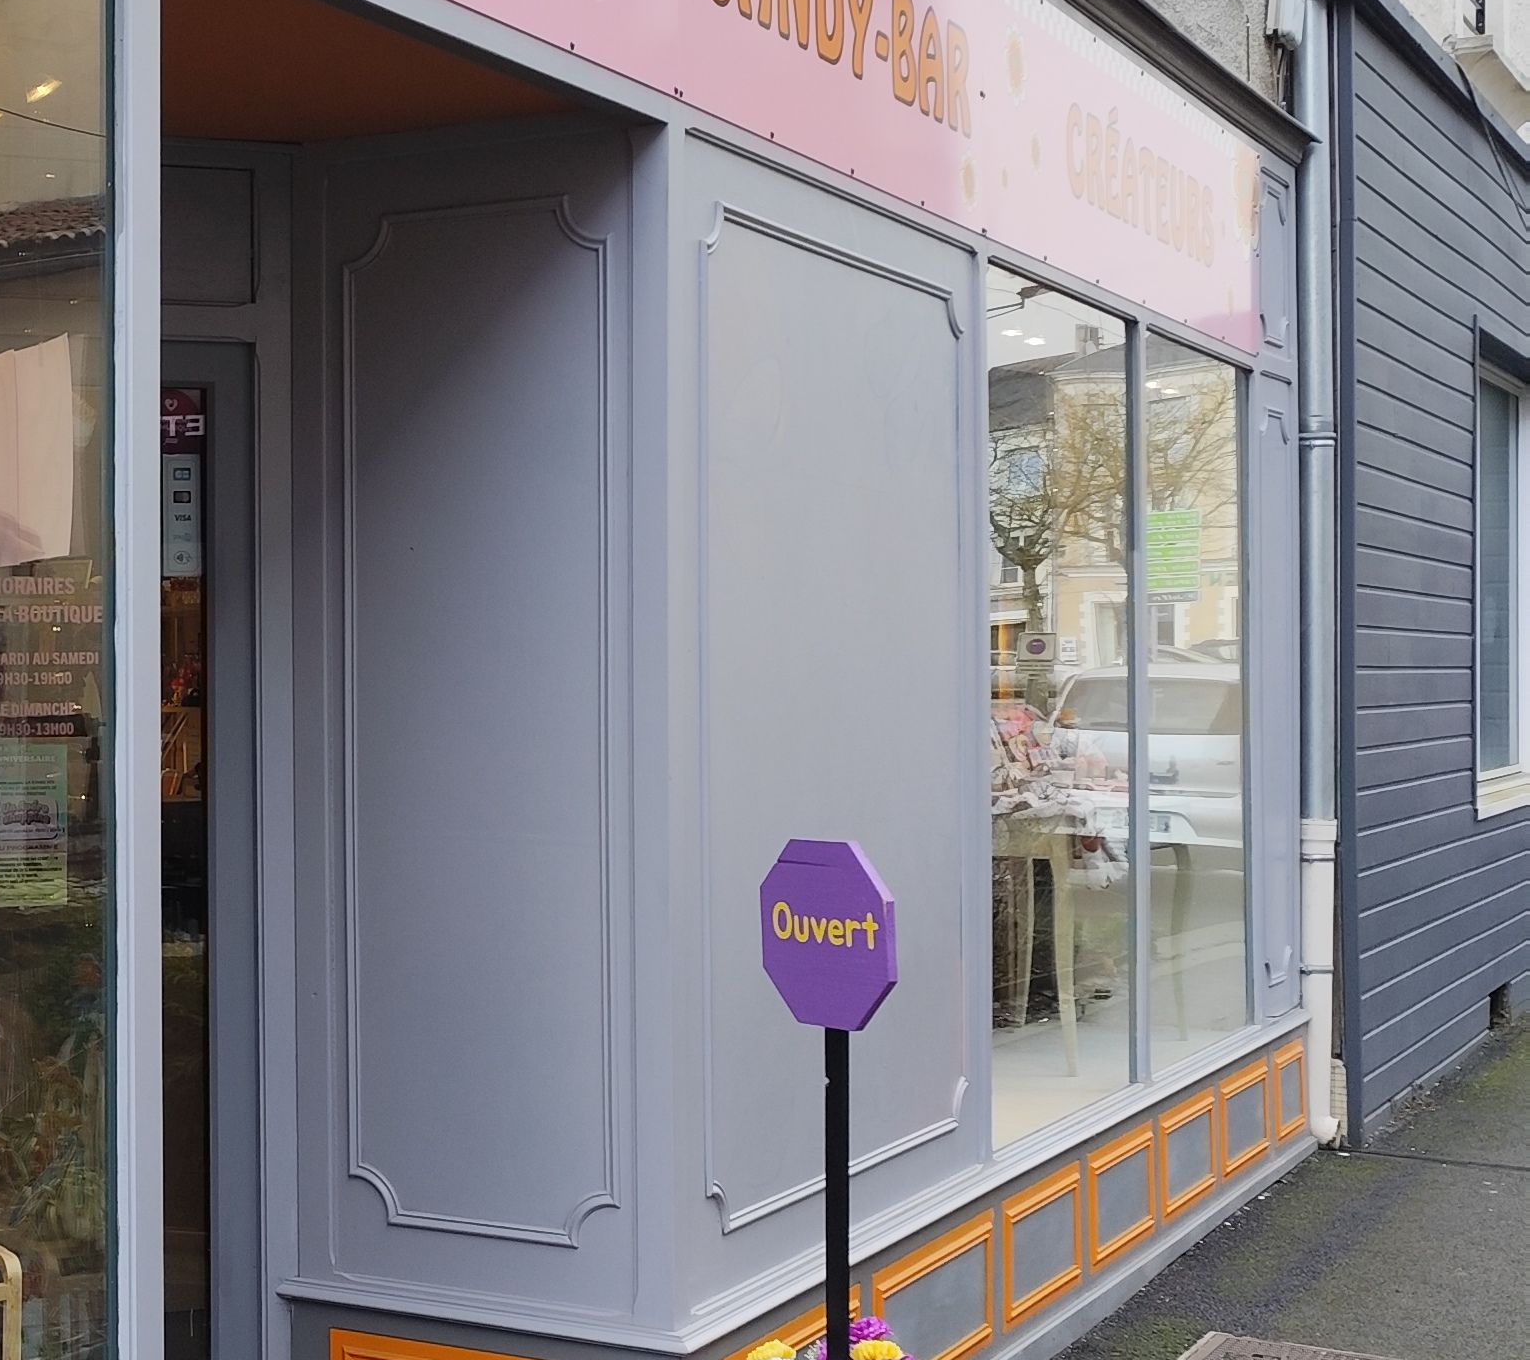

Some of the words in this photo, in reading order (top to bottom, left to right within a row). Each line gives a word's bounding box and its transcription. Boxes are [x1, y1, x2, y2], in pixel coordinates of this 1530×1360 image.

[1066, 102, 1215, 268] CRÉATEURS
[174, 514, 192, 522] VISA
[19, 605, 103, 624] BOUTIQUE
[32, 652, 50, 665] AU
[52, 652, 100, 665] SAMEDI
[11, 702, 77, 716] DIMANCHE
[772, 901, 879, 950] Ouvert
